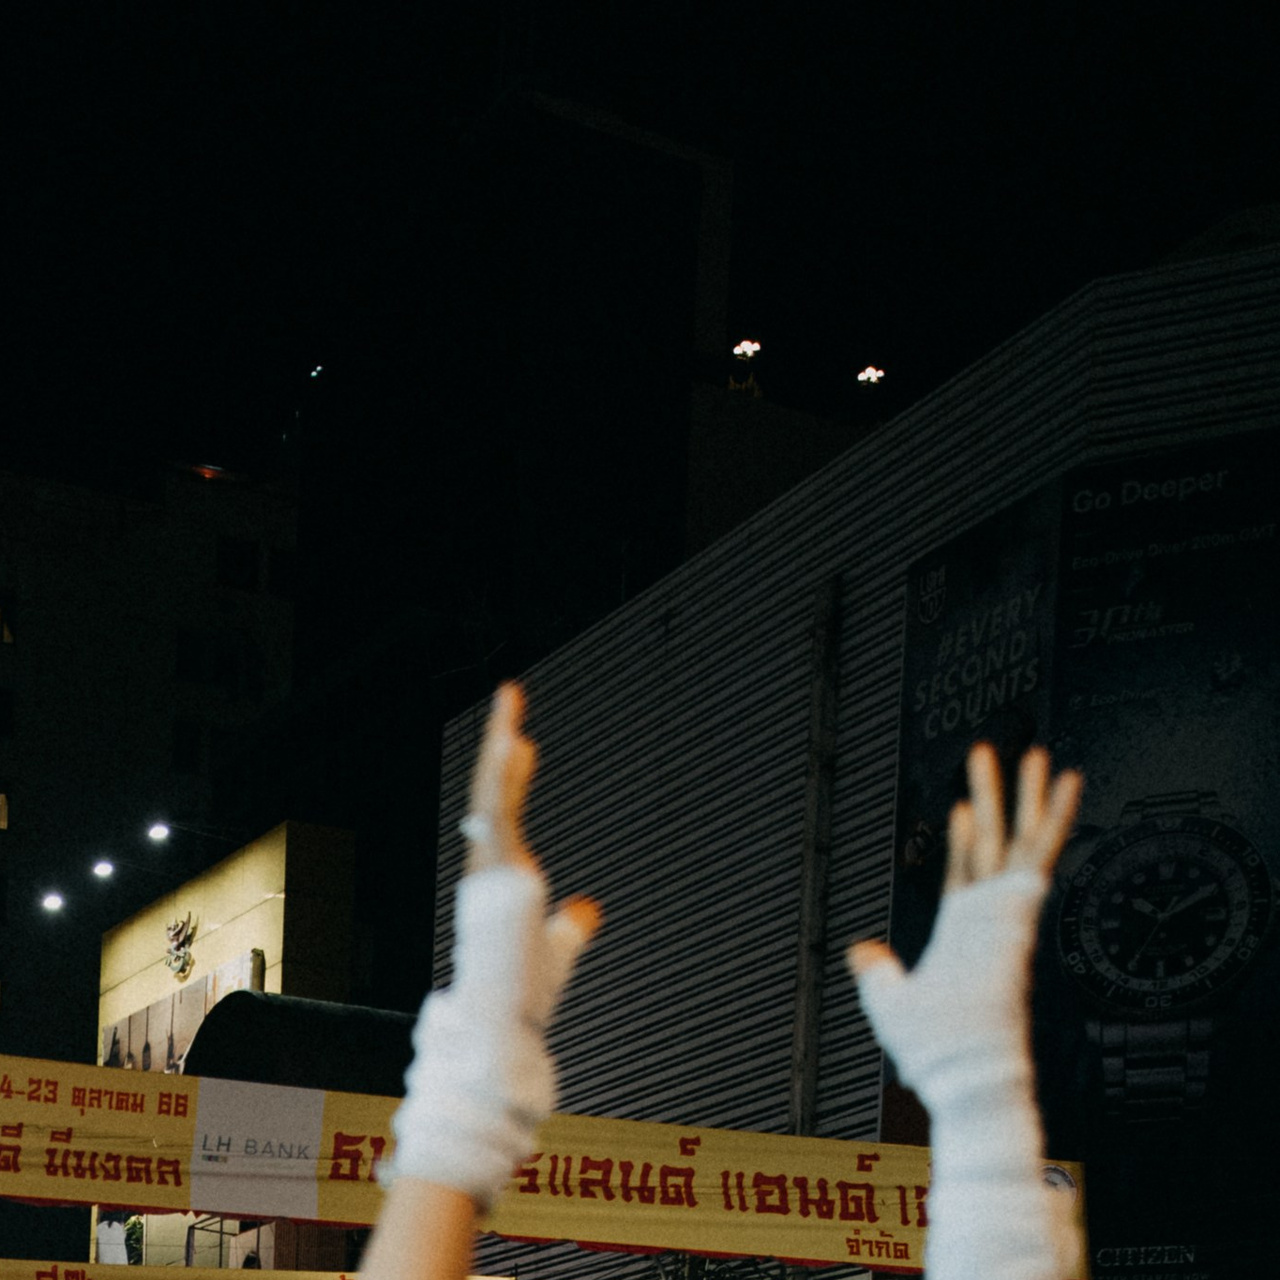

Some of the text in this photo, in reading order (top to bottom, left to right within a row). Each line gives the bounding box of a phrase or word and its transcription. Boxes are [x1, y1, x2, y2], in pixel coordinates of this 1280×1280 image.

[71, 1086, 146, 1117] ตุลาคม
[157, 1091, 189, 1118] 66
[44, 1126, 184, 1188] มีมงคล
[202, 1133, 311, 1161] LH BANK
[845, 1228, 911, 1261] จำกัด
[1096, 1244, 1196, 1267] CITIZEN
